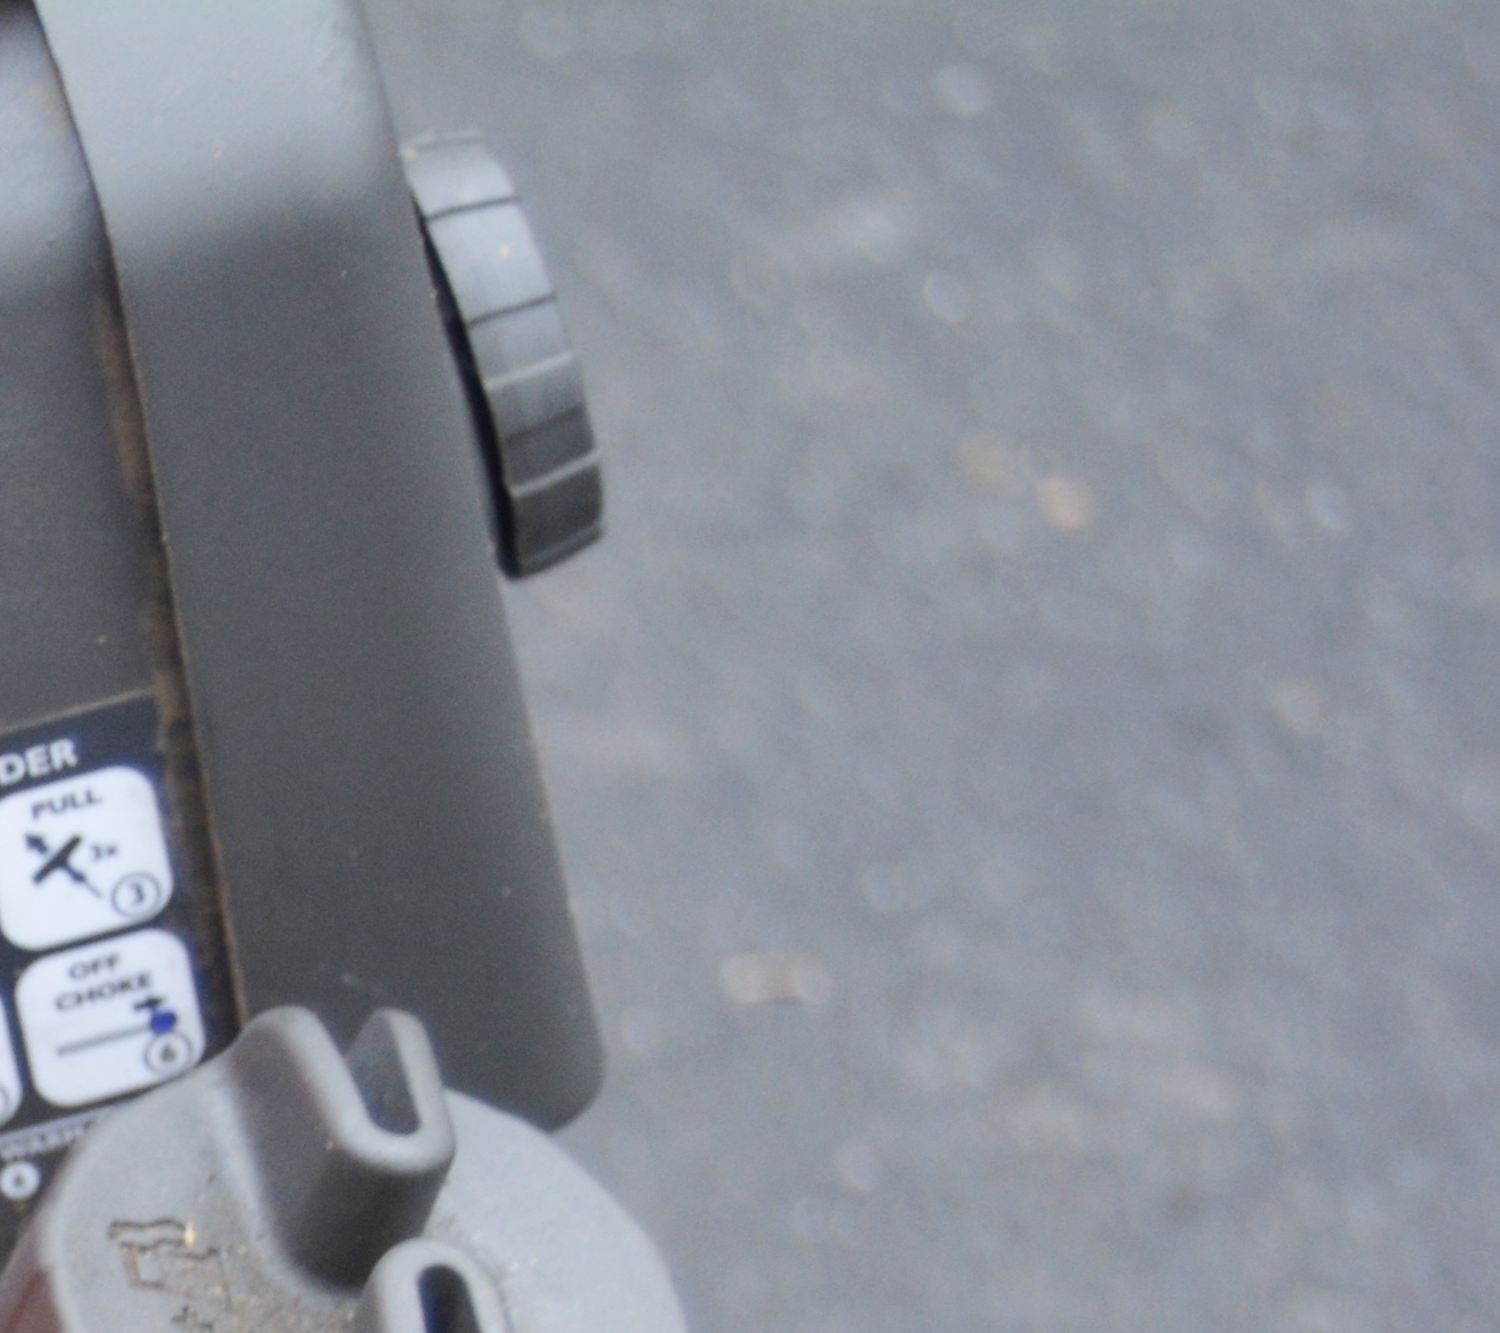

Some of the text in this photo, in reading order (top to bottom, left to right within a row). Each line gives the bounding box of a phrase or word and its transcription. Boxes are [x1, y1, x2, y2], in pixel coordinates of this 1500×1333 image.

[32, 788, 101, 820] PULL
[69, 954, 121, 981] OFF
[56, 972, 153, 1012] CHOKE
